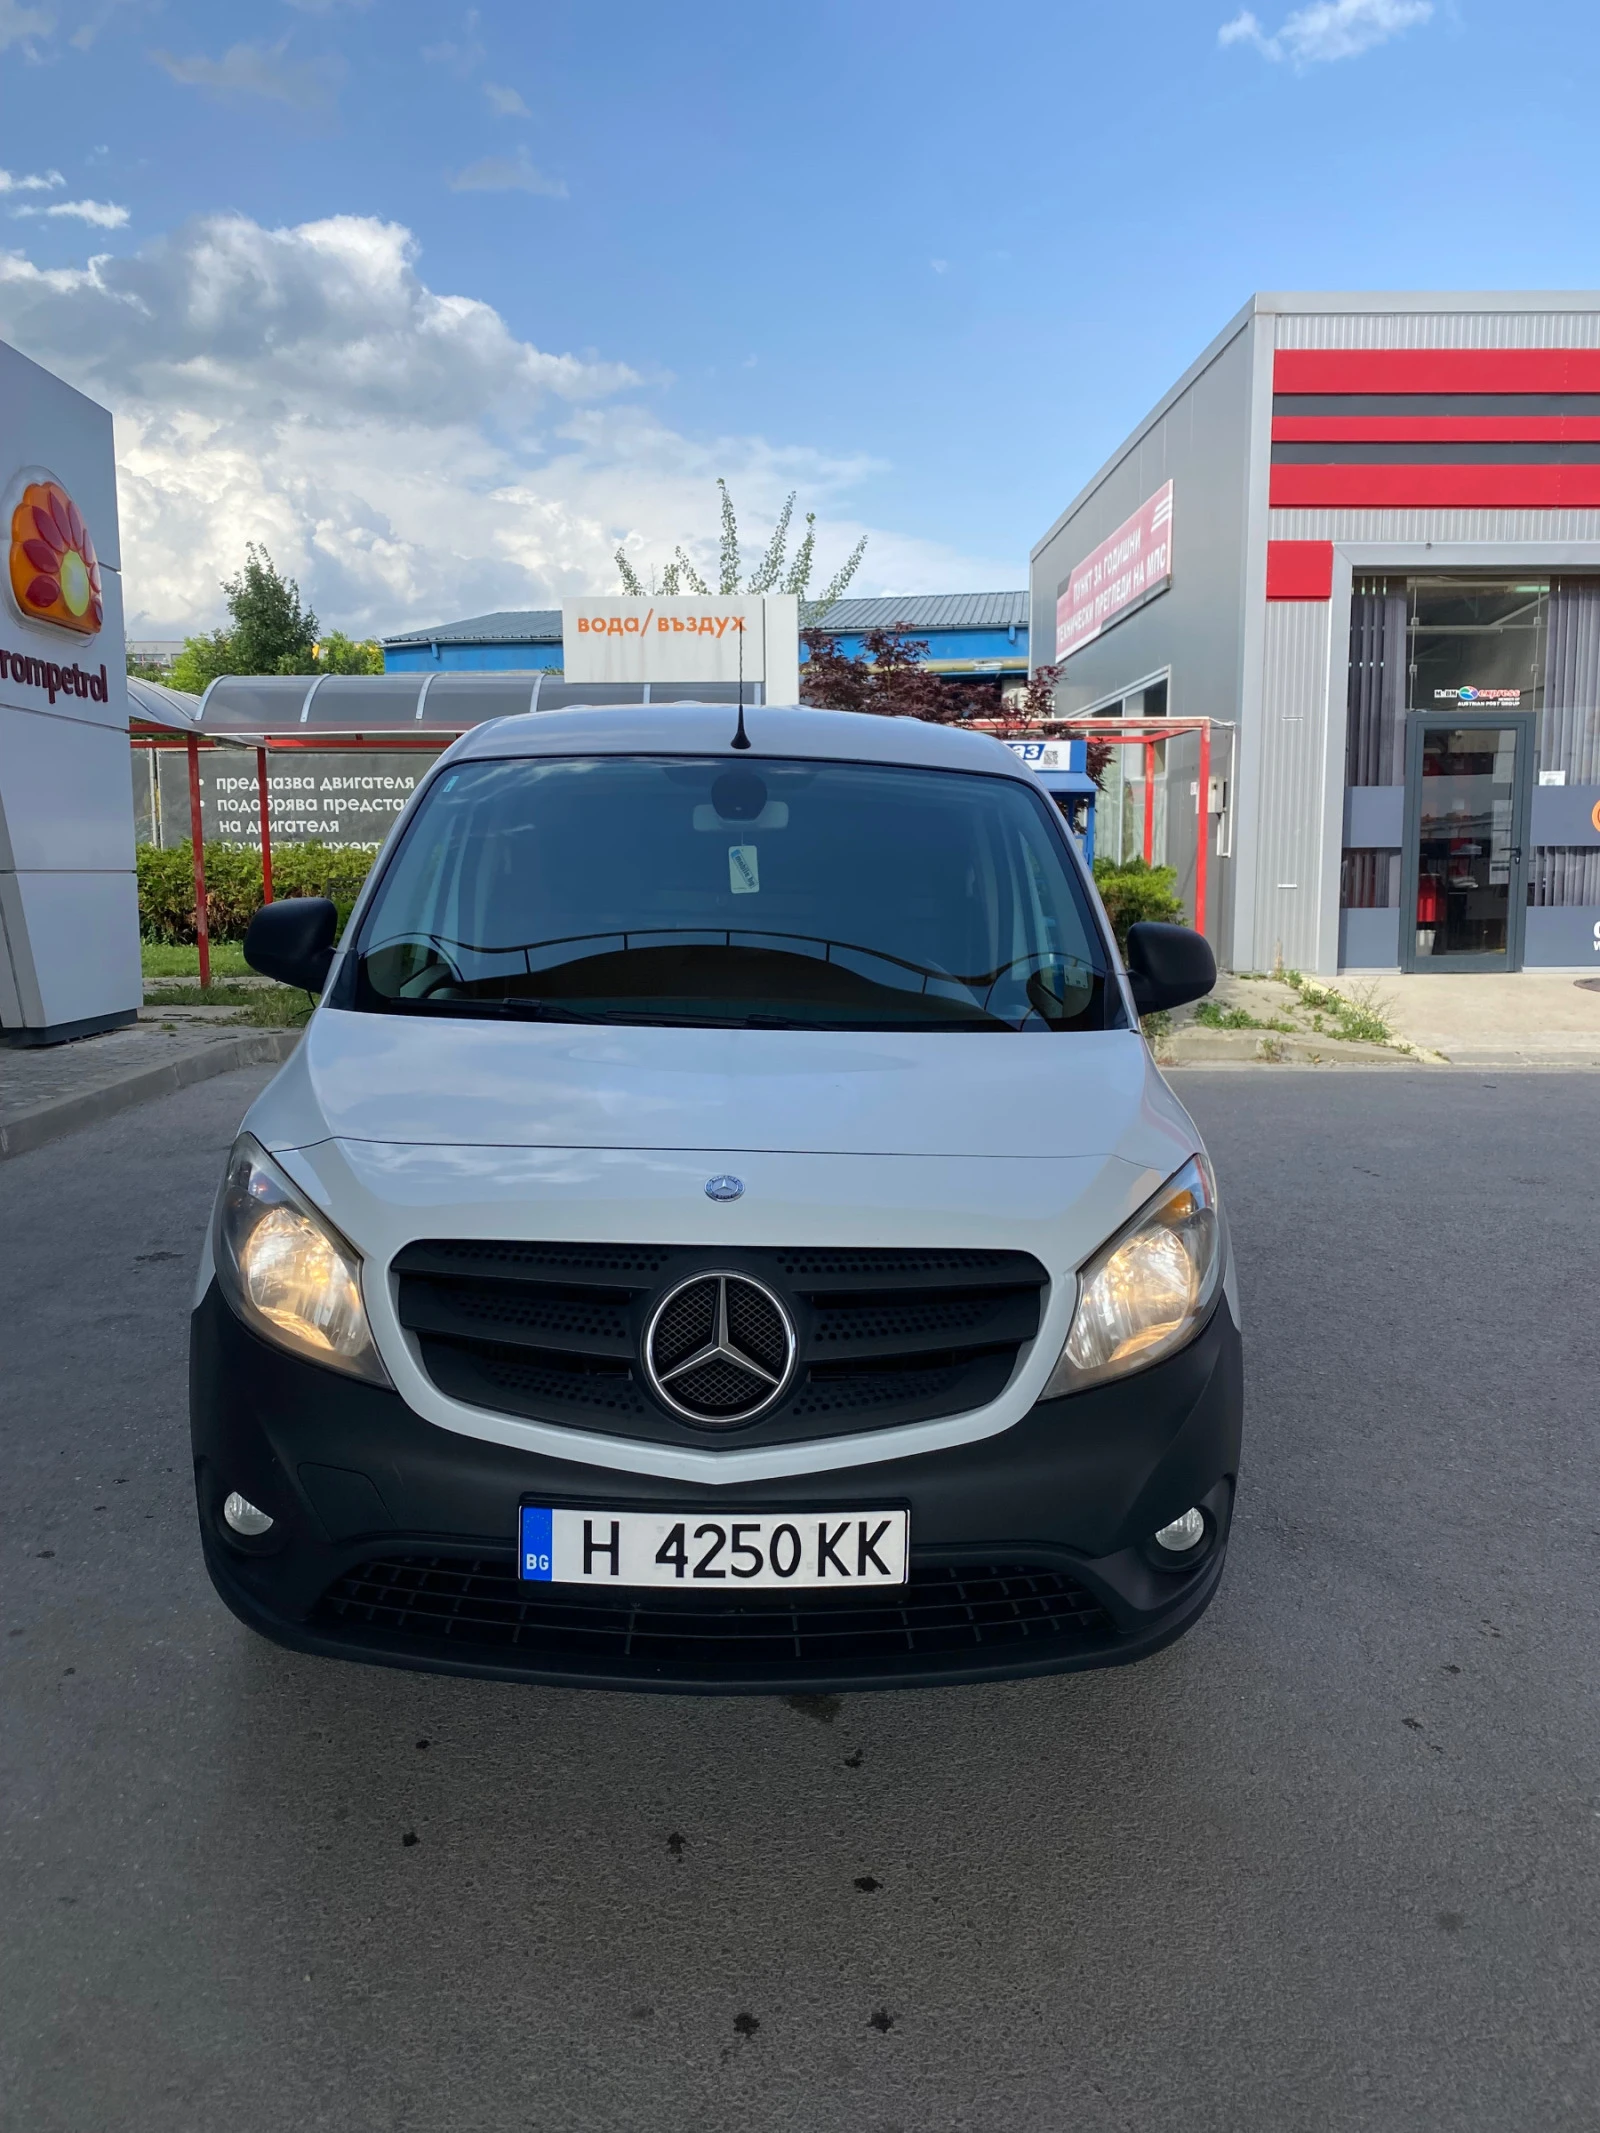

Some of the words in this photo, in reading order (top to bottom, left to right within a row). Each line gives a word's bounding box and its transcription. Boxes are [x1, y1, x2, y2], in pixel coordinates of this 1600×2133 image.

[1093, 561, 1102, 587] ЗА
[1103, 527, 1141, 579] ГОДИШНИ
[1095, 569, 1131, 618] ПРЕГЛЕДИ
[1132, 560, 1145, 591] НА
[1146, 542, 1167, 580] МПС
[577, 607, 747, 639] вода/въздух
[0, 649, 109, 704] rompetrol
[319, 777, 415, 792] двигателя
[323, 798, 409, 815] предста
[219, 820, 241, 833] на
[525, 1553, 550, 1571] BG
[583, 1519, 620, 1576] H
[655, 1522, 802, 1579] 4250
[816, 1519, 893, 1578] KK
